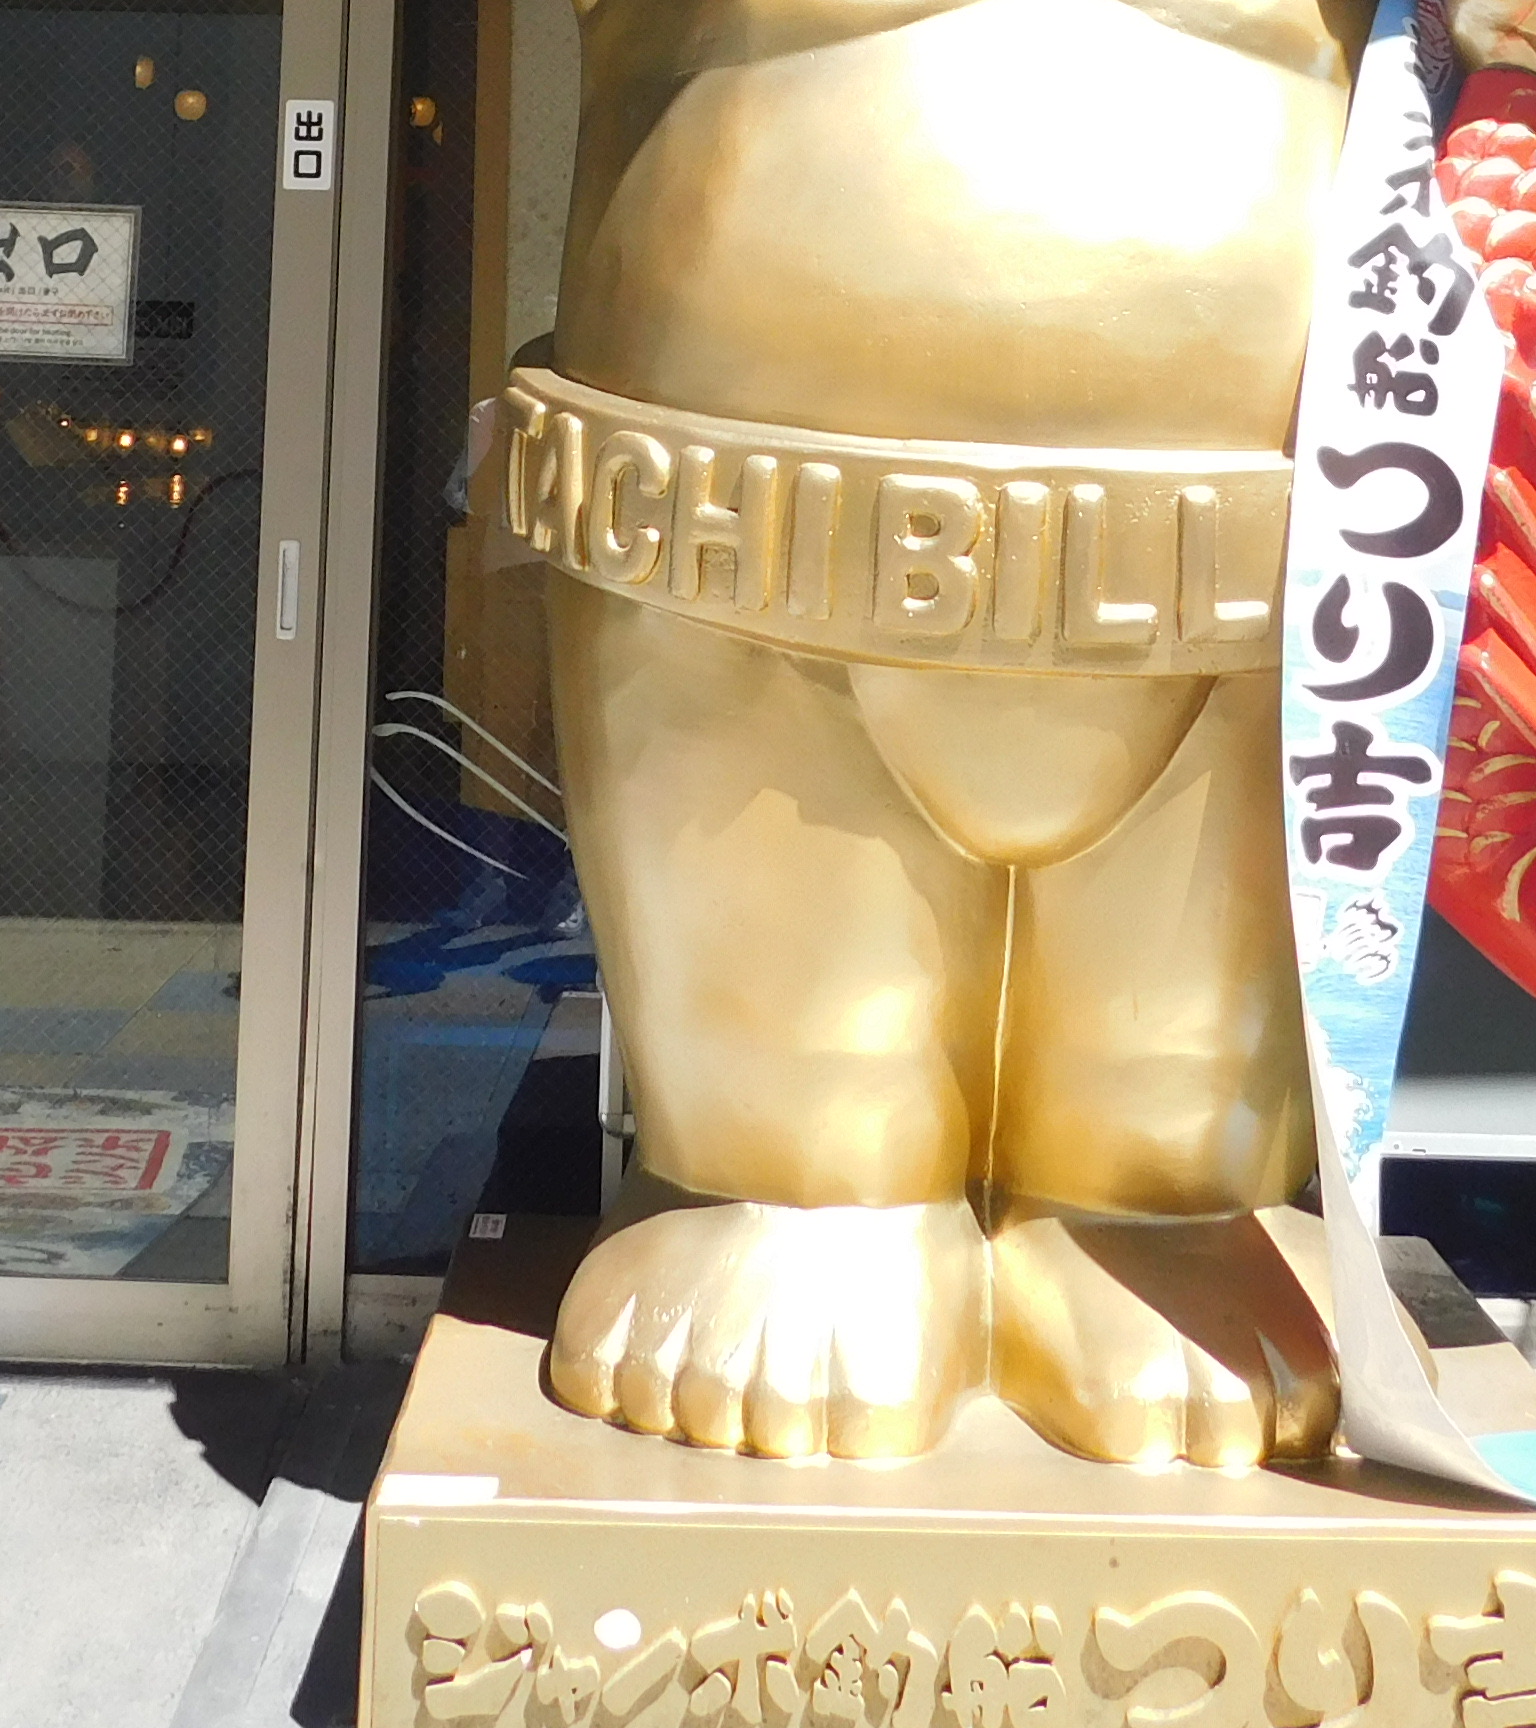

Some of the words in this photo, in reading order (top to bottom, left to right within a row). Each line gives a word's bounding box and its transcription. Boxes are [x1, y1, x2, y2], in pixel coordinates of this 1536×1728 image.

[293, 110, 324, 179] 出口
[506, 386, 842, 620] TACHI
[872, 472, 1292, 646] BILL
